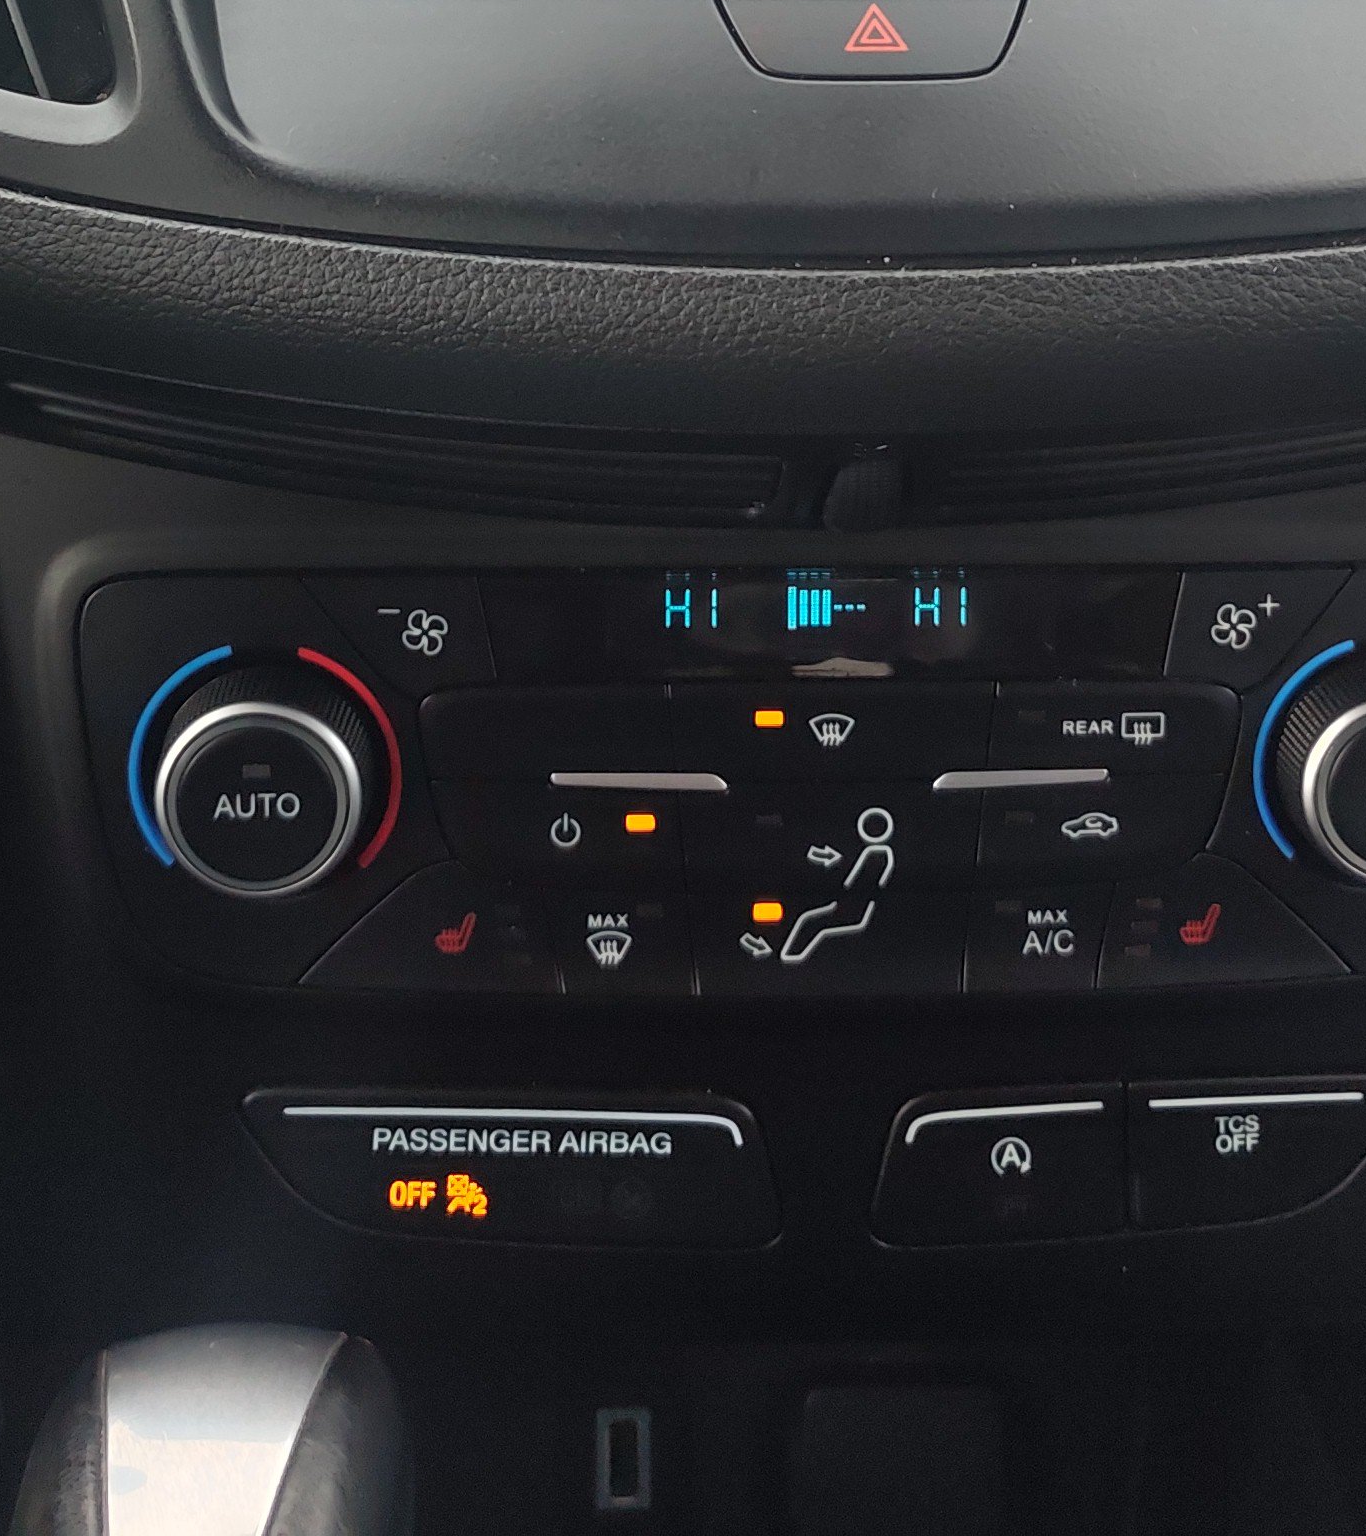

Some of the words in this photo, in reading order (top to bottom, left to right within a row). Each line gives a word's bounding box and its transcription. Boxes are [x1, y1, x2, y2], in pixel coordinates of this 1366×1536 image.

[1062, 719, 1115, 736] REAR
[213, 791, 302, 821] AUTO
[587, 912, 630, 929] MAX
[1026, 909, 1069, 925] MAX
[1021, 929, 1075, 956] A/C
[1214, 1114, 1260, 1135] TCS
[371, 1127, 551, 1153] PASSENGER
[557, 1130, 673, 1155] AIRBAG
[1214, 1133, 1260, 1155] OFF
[388, 1179, 437, 1208] OFF
